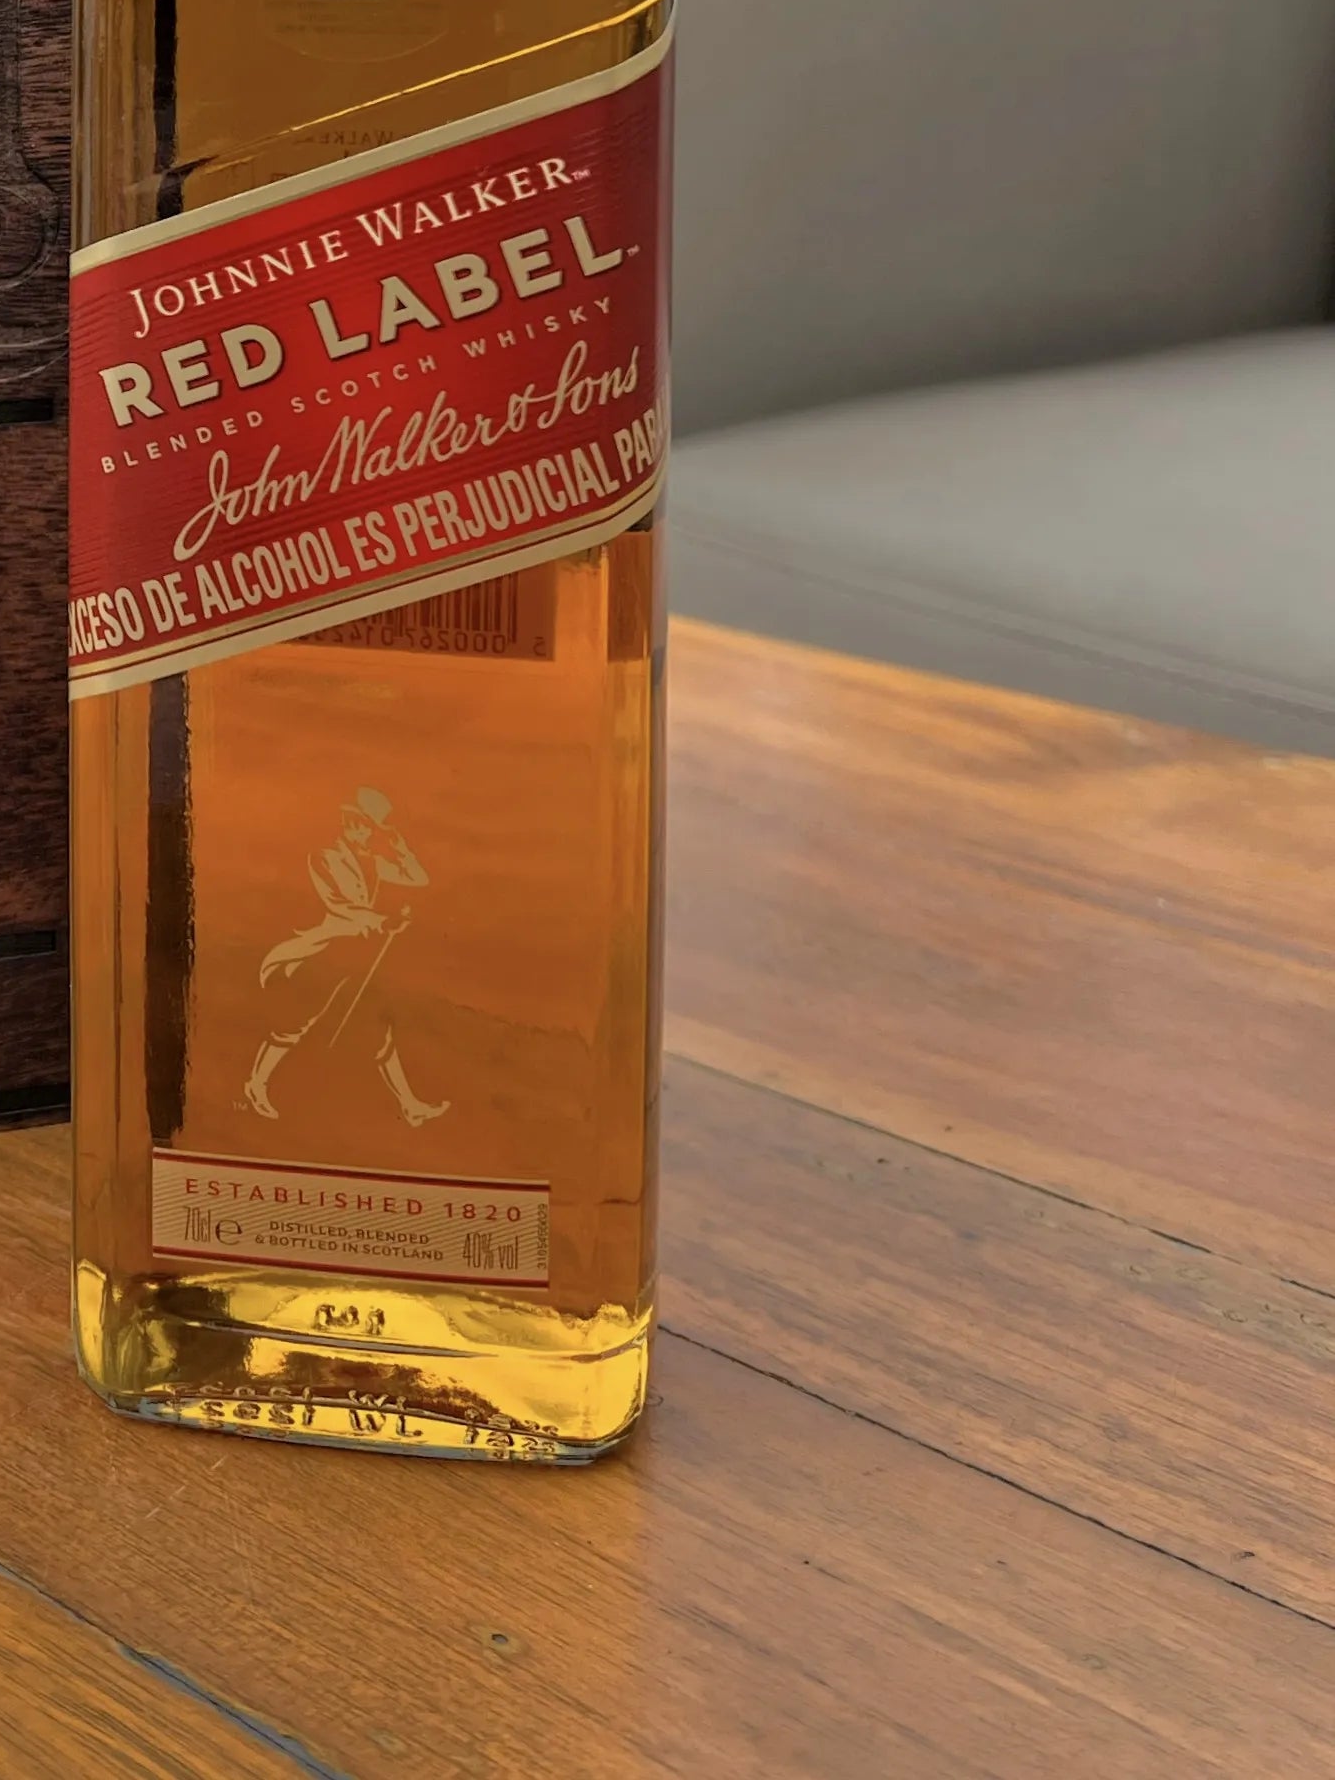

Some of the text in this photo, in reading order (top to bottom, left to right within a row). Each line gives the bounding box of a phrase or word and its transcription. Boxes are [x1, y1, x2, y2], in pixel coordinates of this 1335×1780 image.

[130, 229, 350, 340] JOHNNIE
[98, 323, 285, 428] RED
[100, 297, 612, 474] BLENDED SCOTCH WHISKY
[172, 444, 317, 562] John
[310, 390, 502, 494] Walker
[536, 339, 640, 430] Sons
[141, 571, 198, 634] DE
[194, 526, 351, 620] ALCOHOL
[342, 510, 397, 572] ES
[393, 442, 621, 558] PERJUDICIAL
[184, 1177, 522, 1222] ESTABLISHED 1820
[268, 1219, 431, 1246] DISTILLED, BLENDED
[268, 1234, 339, 1253] BOTTLED
[342, 1241, 361, 1254] IN
[362, 1242, 445, 1262] SCOTLAND
